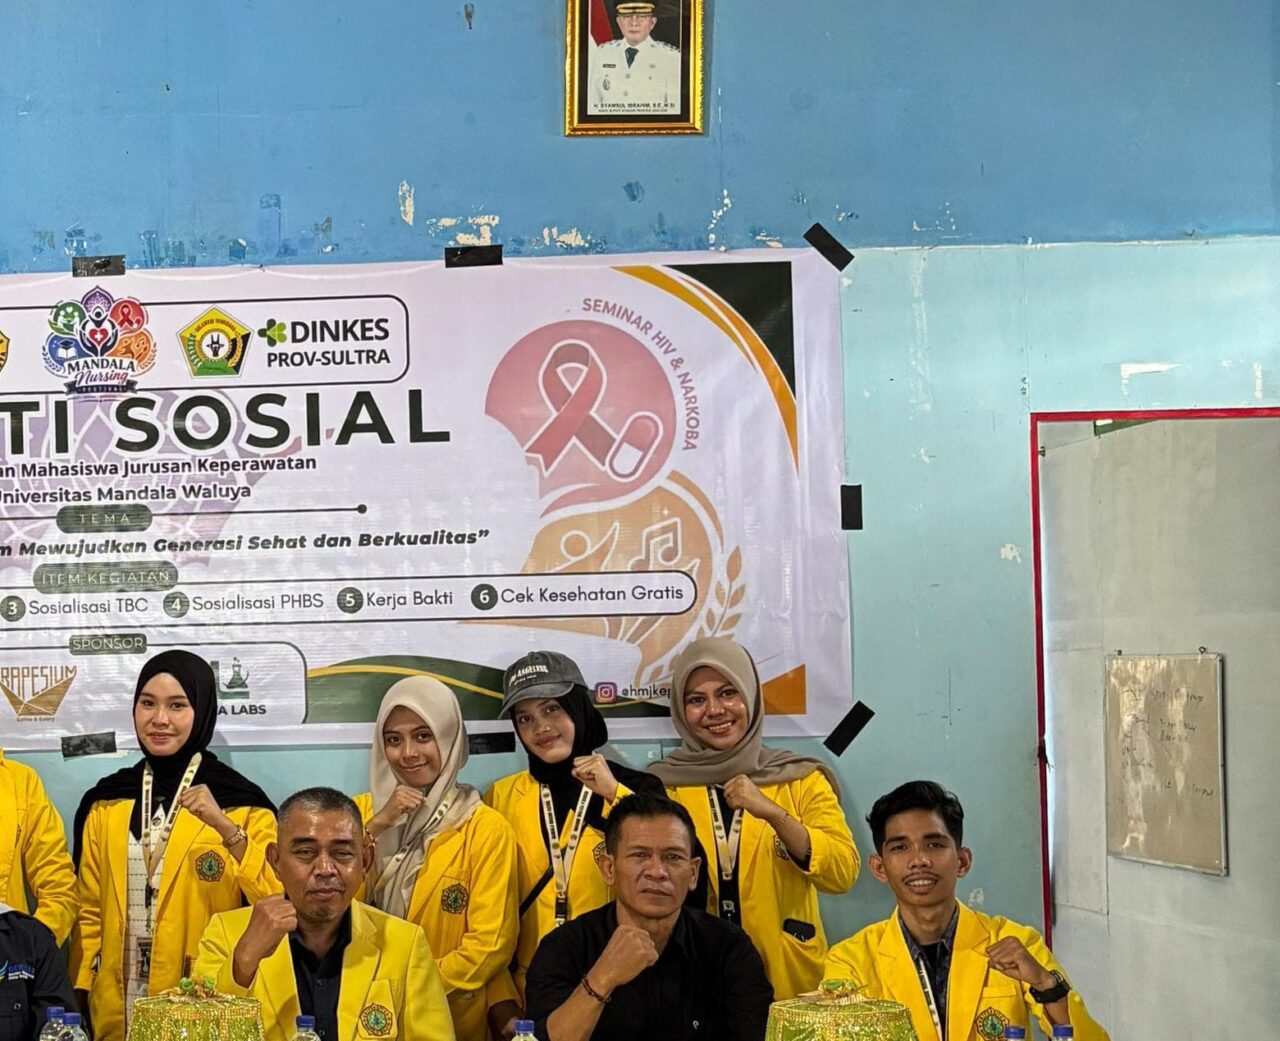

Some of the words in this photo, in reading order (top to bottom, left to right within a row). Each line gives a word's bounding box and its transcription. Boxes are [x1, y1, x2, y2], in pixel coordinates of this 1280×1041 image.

[291, 318, 390, 343] DINKES
[67, 358, 136, 375] MANDALA
[267, 349, 391, 367] PROV-SULTRA
[74, 370, 130, 386] Nursing
[582, 298, 653, 335] SEMINAR
[651, 331, 677, 355] HIV
[670, 357, 684, 371] &
[677, 371, 700, 451] NARKOBA
[115, 389, 451, 453] SOSIAL
[20, 461, 119, 478] Mahasiswa
[123, 458, 192, 477] Jurusan
[197, 456, 317, 477] Keperawatan
[97, 485, 177, 502] Mandala
[182, 484, 252, 502] Waluya
[79, 513, 131, 525] TEMA
[19, 539, 147, 558] Mewujudkan
[153, 535, 243, 553] Generasi
[248, 534, 307, 550] Sehat
[313, 534, 352, 548] dan
[7, 601, 18, 615] 3
[28, 597, 111, 615] Sosialisasi
[116, 598, 148, 613] TBC
[192, 593, 275, 611] Sosialisasi
[281, 593, 324, 609] PHBS
[345, 593, 355, 607] 5
[366, 591, 407, 610] Kerja
[413, 590, 453, 606] Bakti
[479, 590, 490, 604] 6
[501, 586, 534, 604] Cek
[539, 585, 626, 603] Kesehatan
[631, 584, 684, 601] Gratis
[72, 637, 145, 650] SPONSOR
[231, 704, 267, 716] LABS
